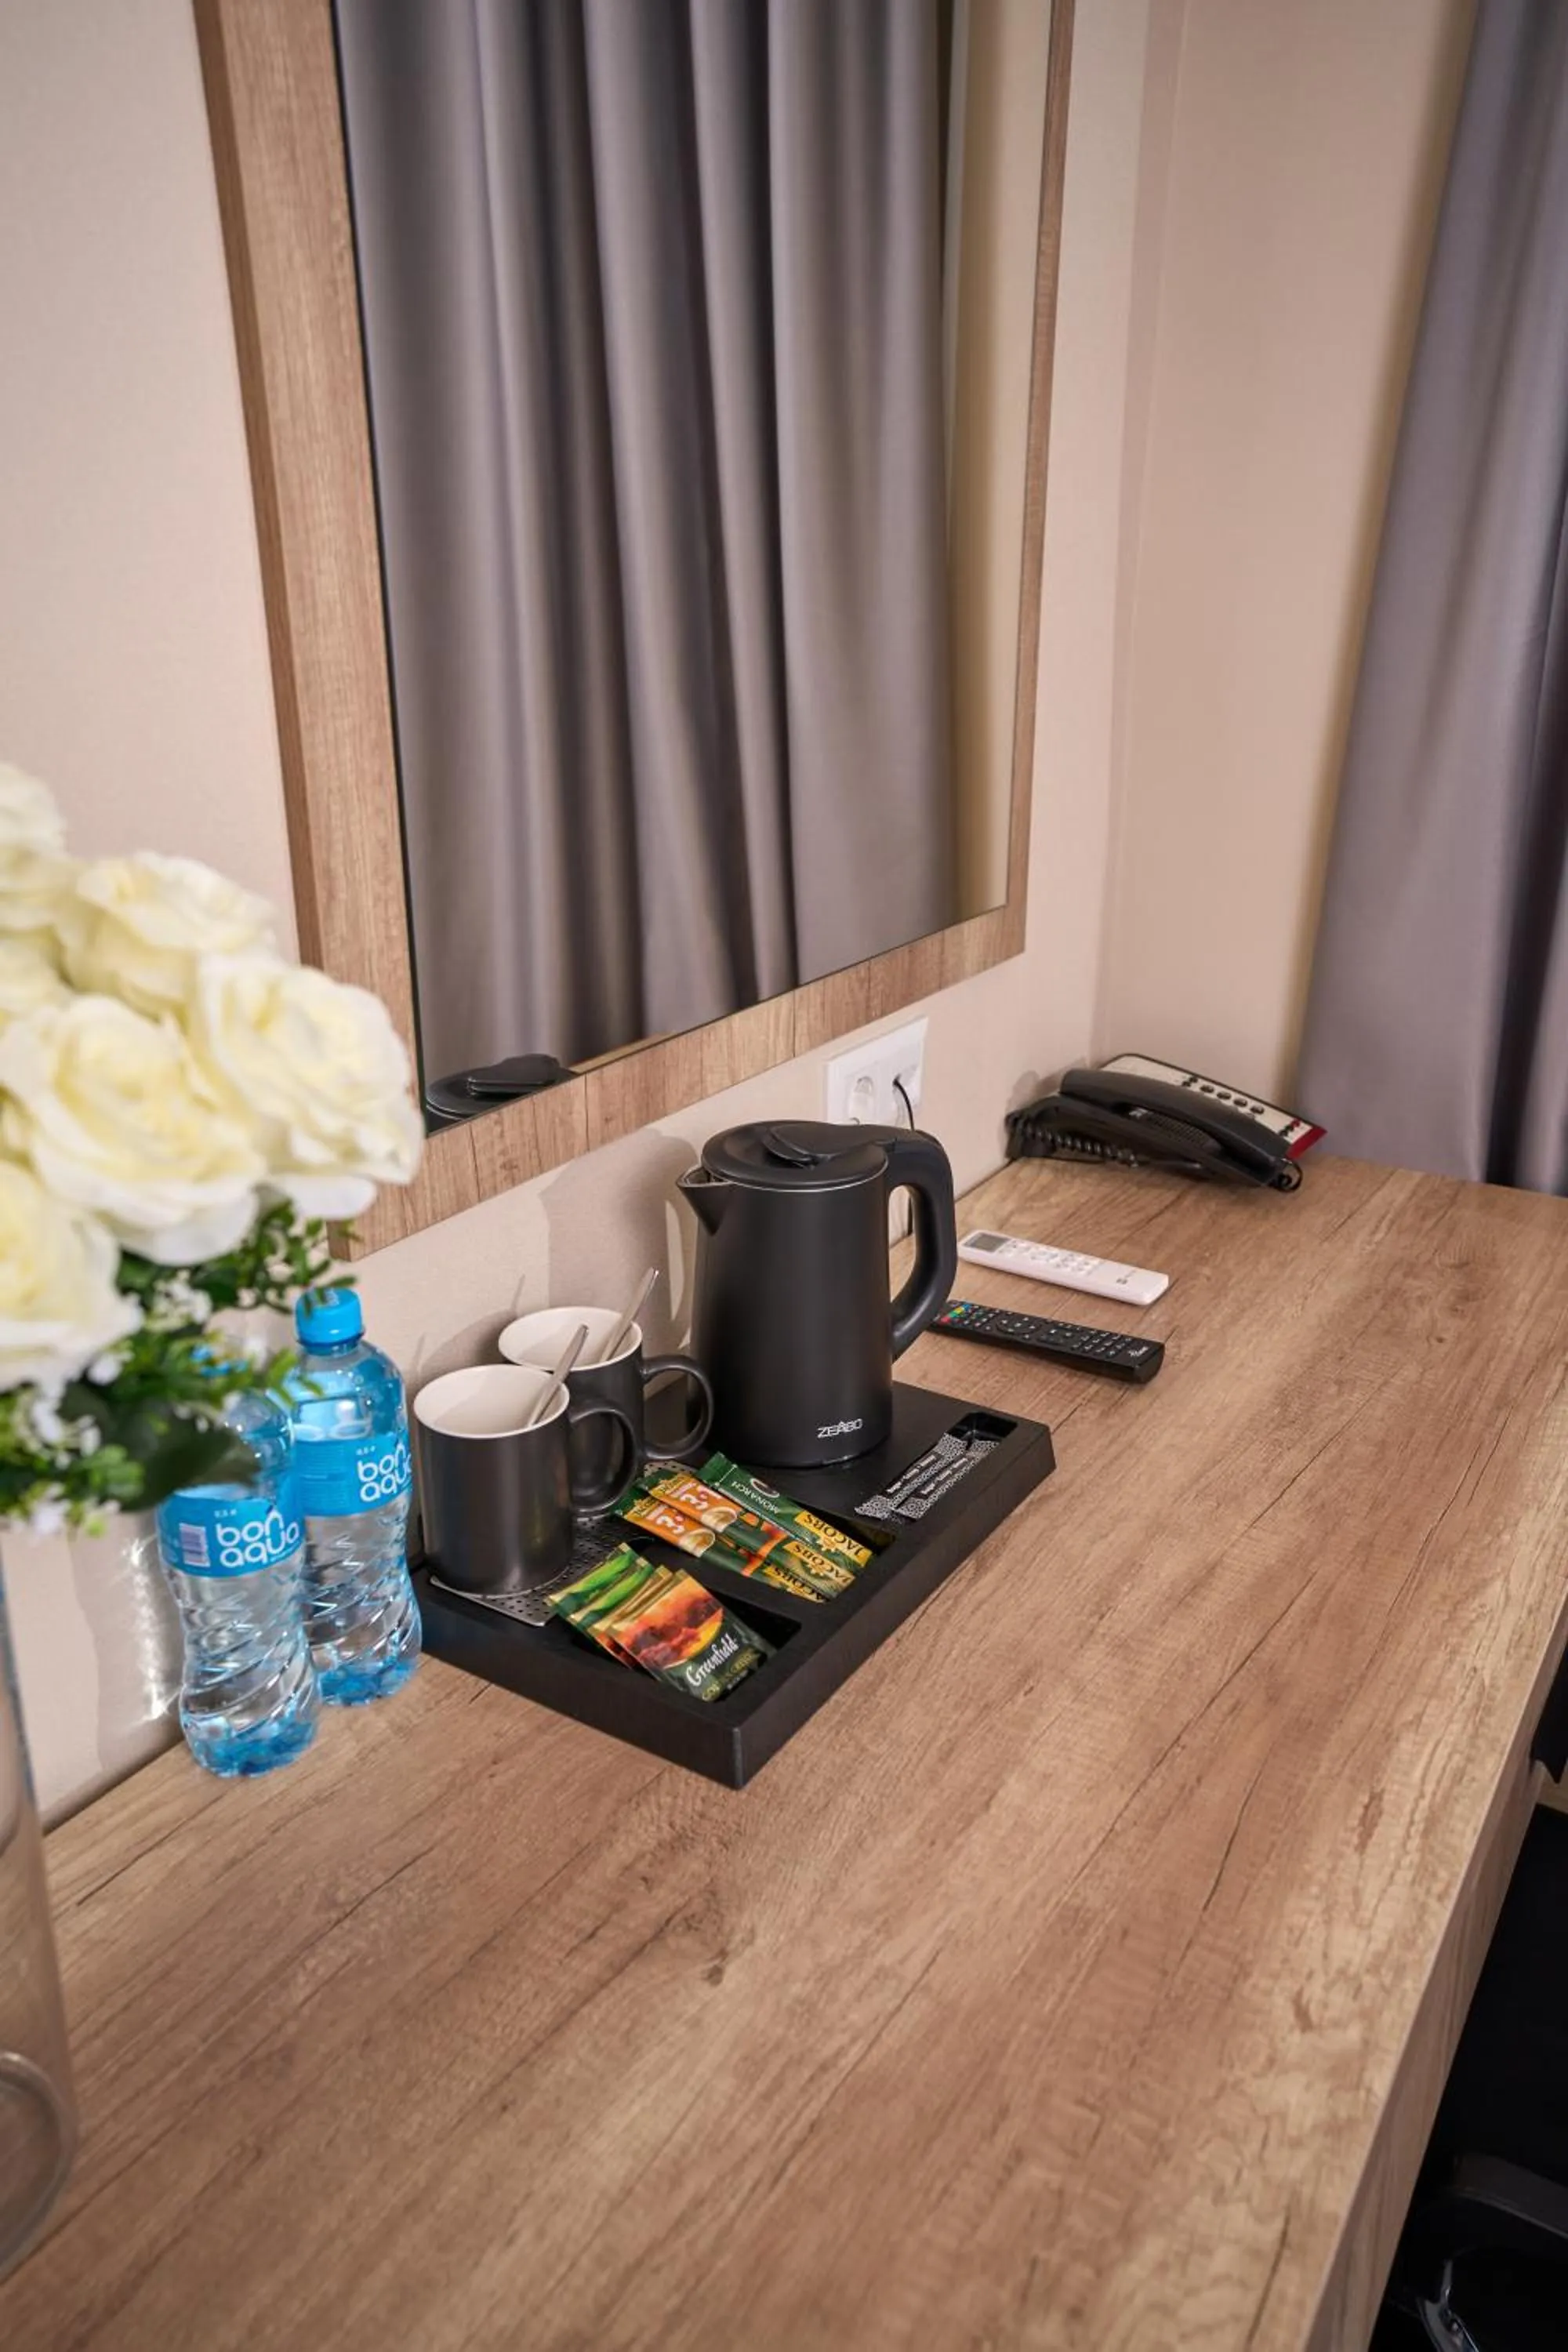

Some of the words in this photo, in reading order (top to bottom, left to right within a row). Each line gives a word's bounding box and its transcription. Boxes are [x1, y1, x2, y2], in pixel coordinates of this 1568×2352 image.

[358, 1443, 406, 1482] bon
[731, 1481, 779, 1515] MONARCH
[216, 1509, 285, 1547] bon
[220, 1522, 299, 1567] aqua
[804, 1514, 863, 1556] JACOBS
[795, 1544, 851, 1583] JACOBS
[775, 1567, 831, 1600] ACOBS
[686, 1633, 739, 1686] Greenfield
